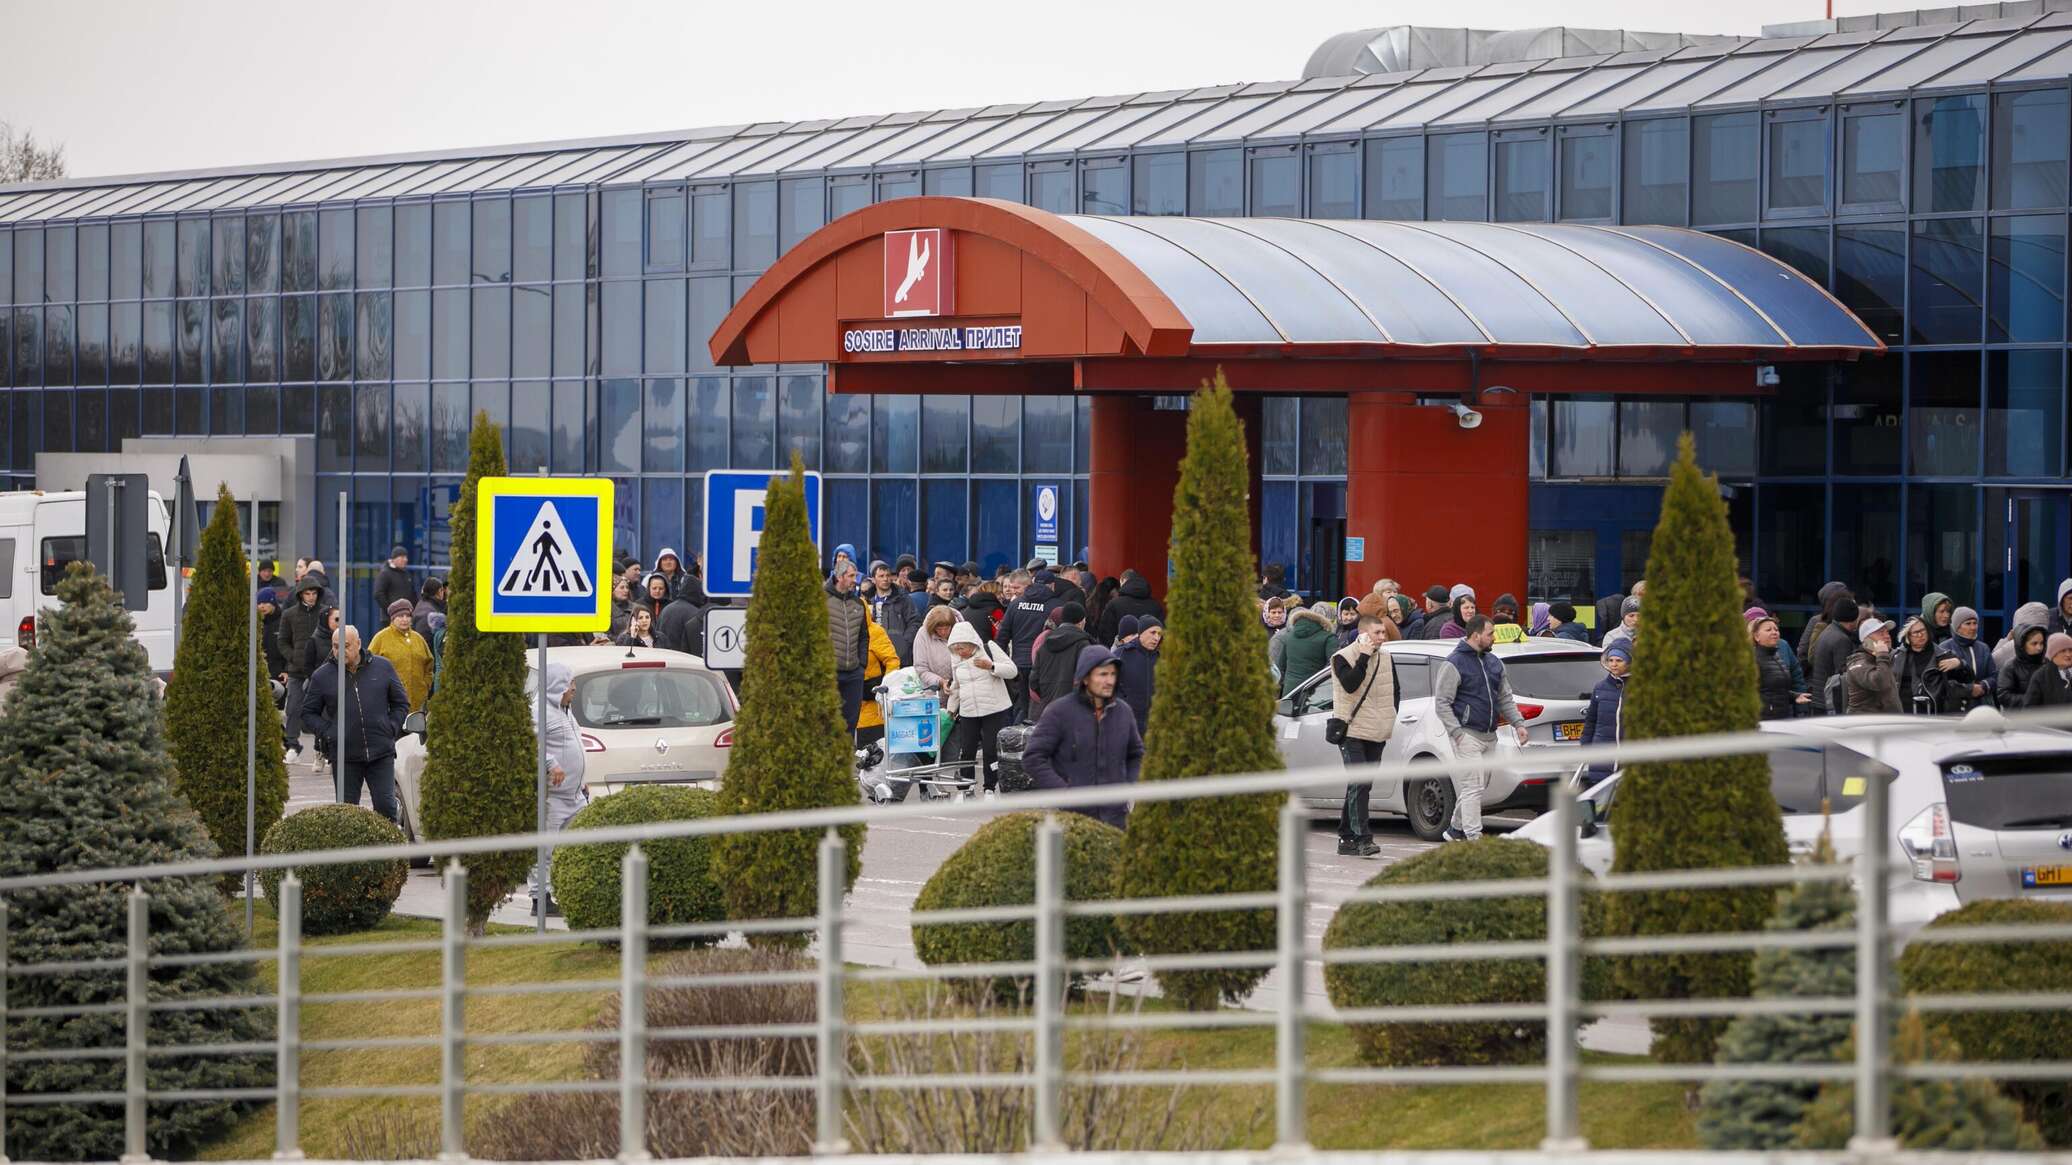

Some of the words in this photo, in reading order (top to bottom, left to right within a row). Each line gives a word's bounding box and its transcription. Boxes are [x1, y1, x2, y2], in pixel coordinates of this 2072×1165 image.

[845, 330, 894, 352] SOSIRE
[899, 328, 961, 350] ARRIVAL
[966, 326, 1021, 349] ПРИЛЕТ
